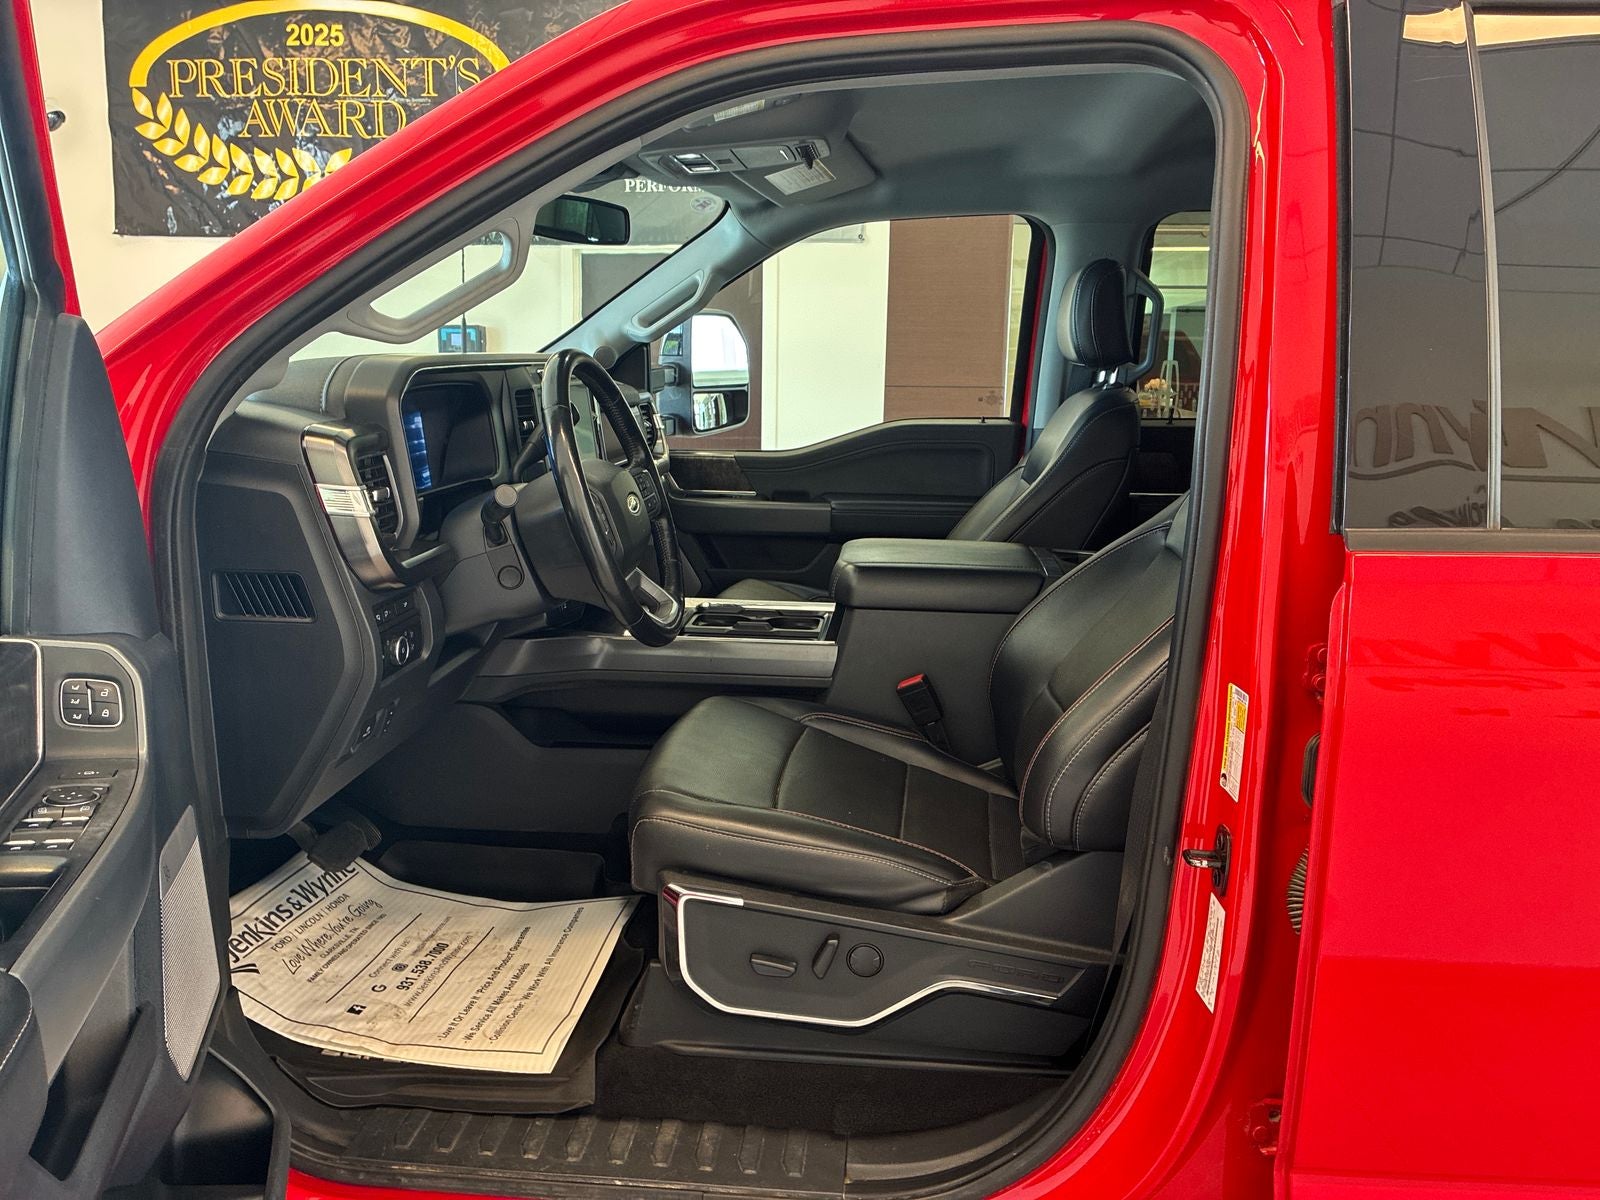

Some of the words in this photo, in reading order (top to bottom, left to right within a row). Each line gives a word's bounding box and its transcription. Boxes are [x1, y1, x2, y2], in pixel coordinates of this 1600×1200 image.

[285, 23, 345, 47] 2025
[166, 55, 482, 98] PRESIDENT'S
[238, 99, 407, 139] AWARD
[270, 935, 293, 952] FORD
[295, 911, 324, 935] LINCOLN
[326, 894, 350, 912] HONDA
[282, 951, 305, 975] Love
[297, 932, 333, 957] Where
[322, 914, 354, 936] You're
[347, 898, 383, 918] Going
[396, 942, 449, 991] 931.538.7000
[438, 1025, 455, 1039] Love
[460, 1000, 477, 1016] Leave
[470, 1013, 492, 1031] Service
